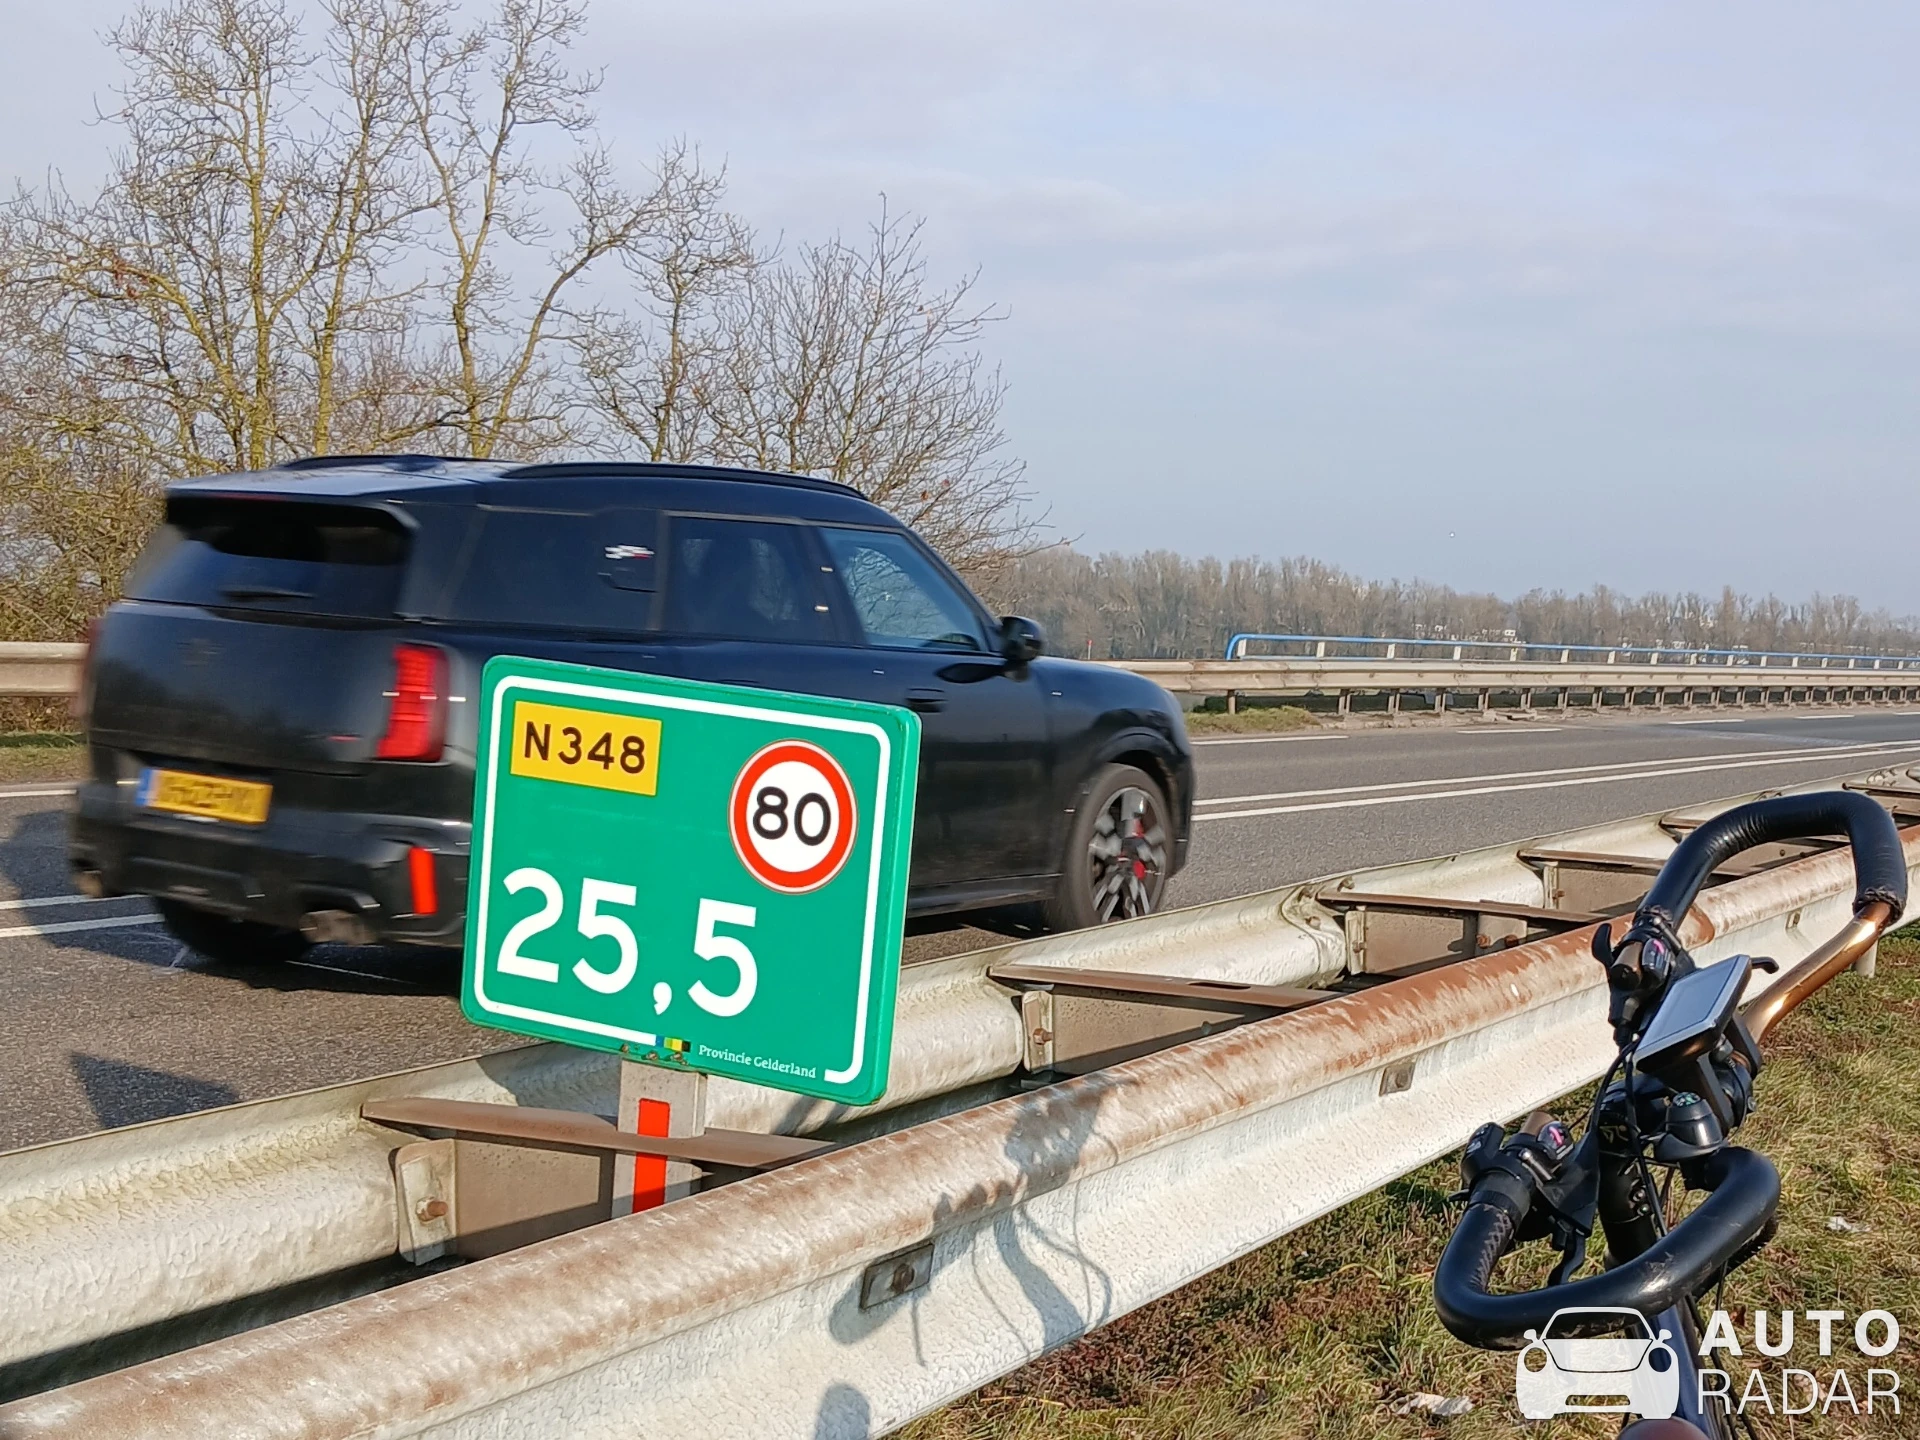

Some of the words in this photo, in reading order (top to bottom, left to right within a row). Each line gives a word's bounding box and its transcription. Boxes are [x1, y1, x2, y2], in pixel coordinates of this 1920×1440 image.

[523, 720, 646, 774] N348
[752, 786, 831, 846] 80
[497, 867, 758, 1017] 25,5
[698, 1044, 752, 1065] Provincie
[753, 1056, 816, 1078] Gelderland
